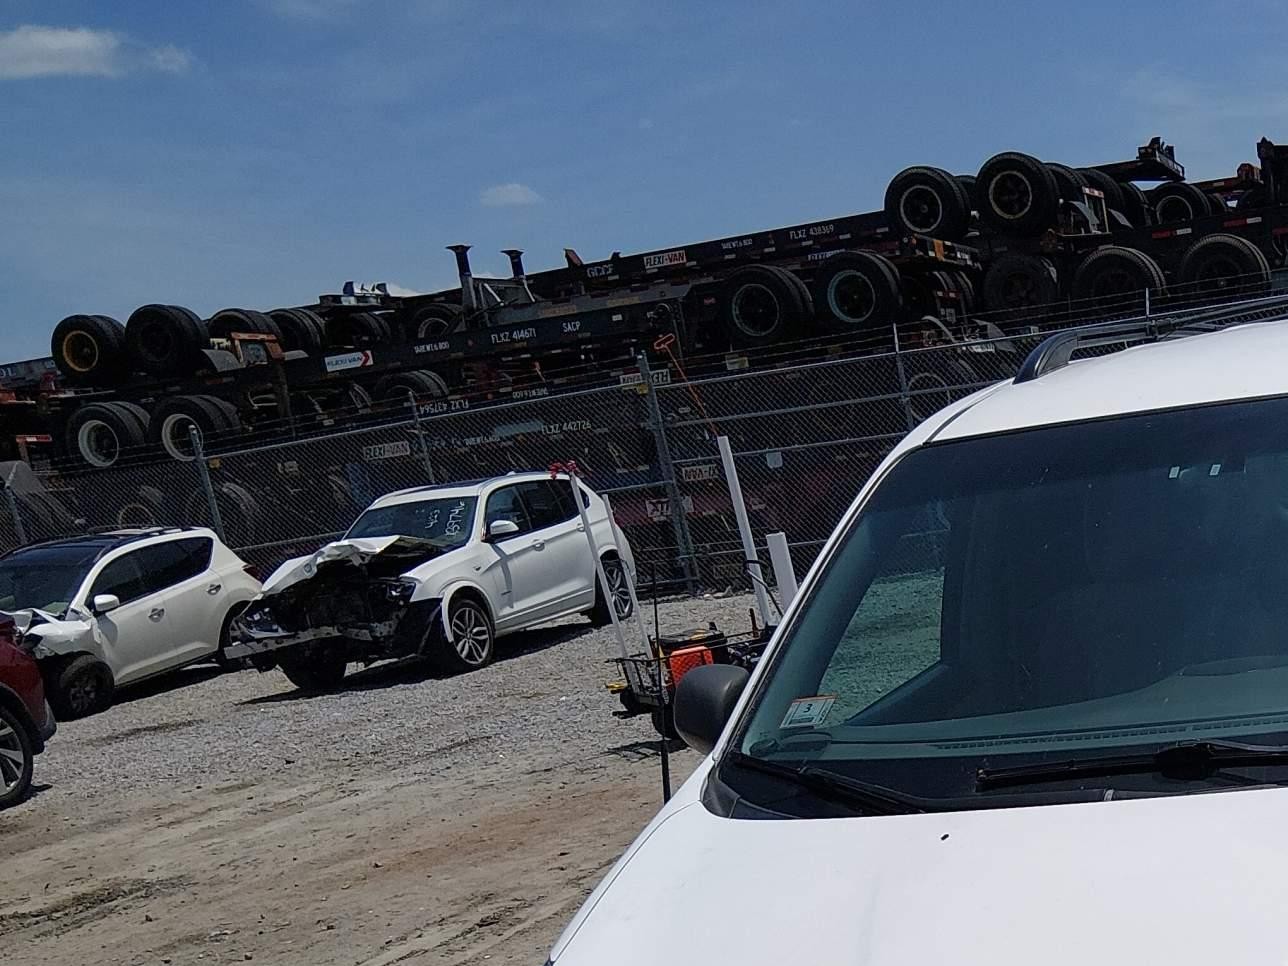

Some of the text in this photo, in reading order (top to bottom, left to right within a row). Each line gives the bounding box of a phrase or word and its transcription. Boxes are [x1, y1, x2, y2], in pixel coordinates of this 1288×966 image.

[645, 251, 685, 267] FLEXI-VAN
[490, 331, 512, 344] FLXZ
[803, 703, 813, 713] 3
